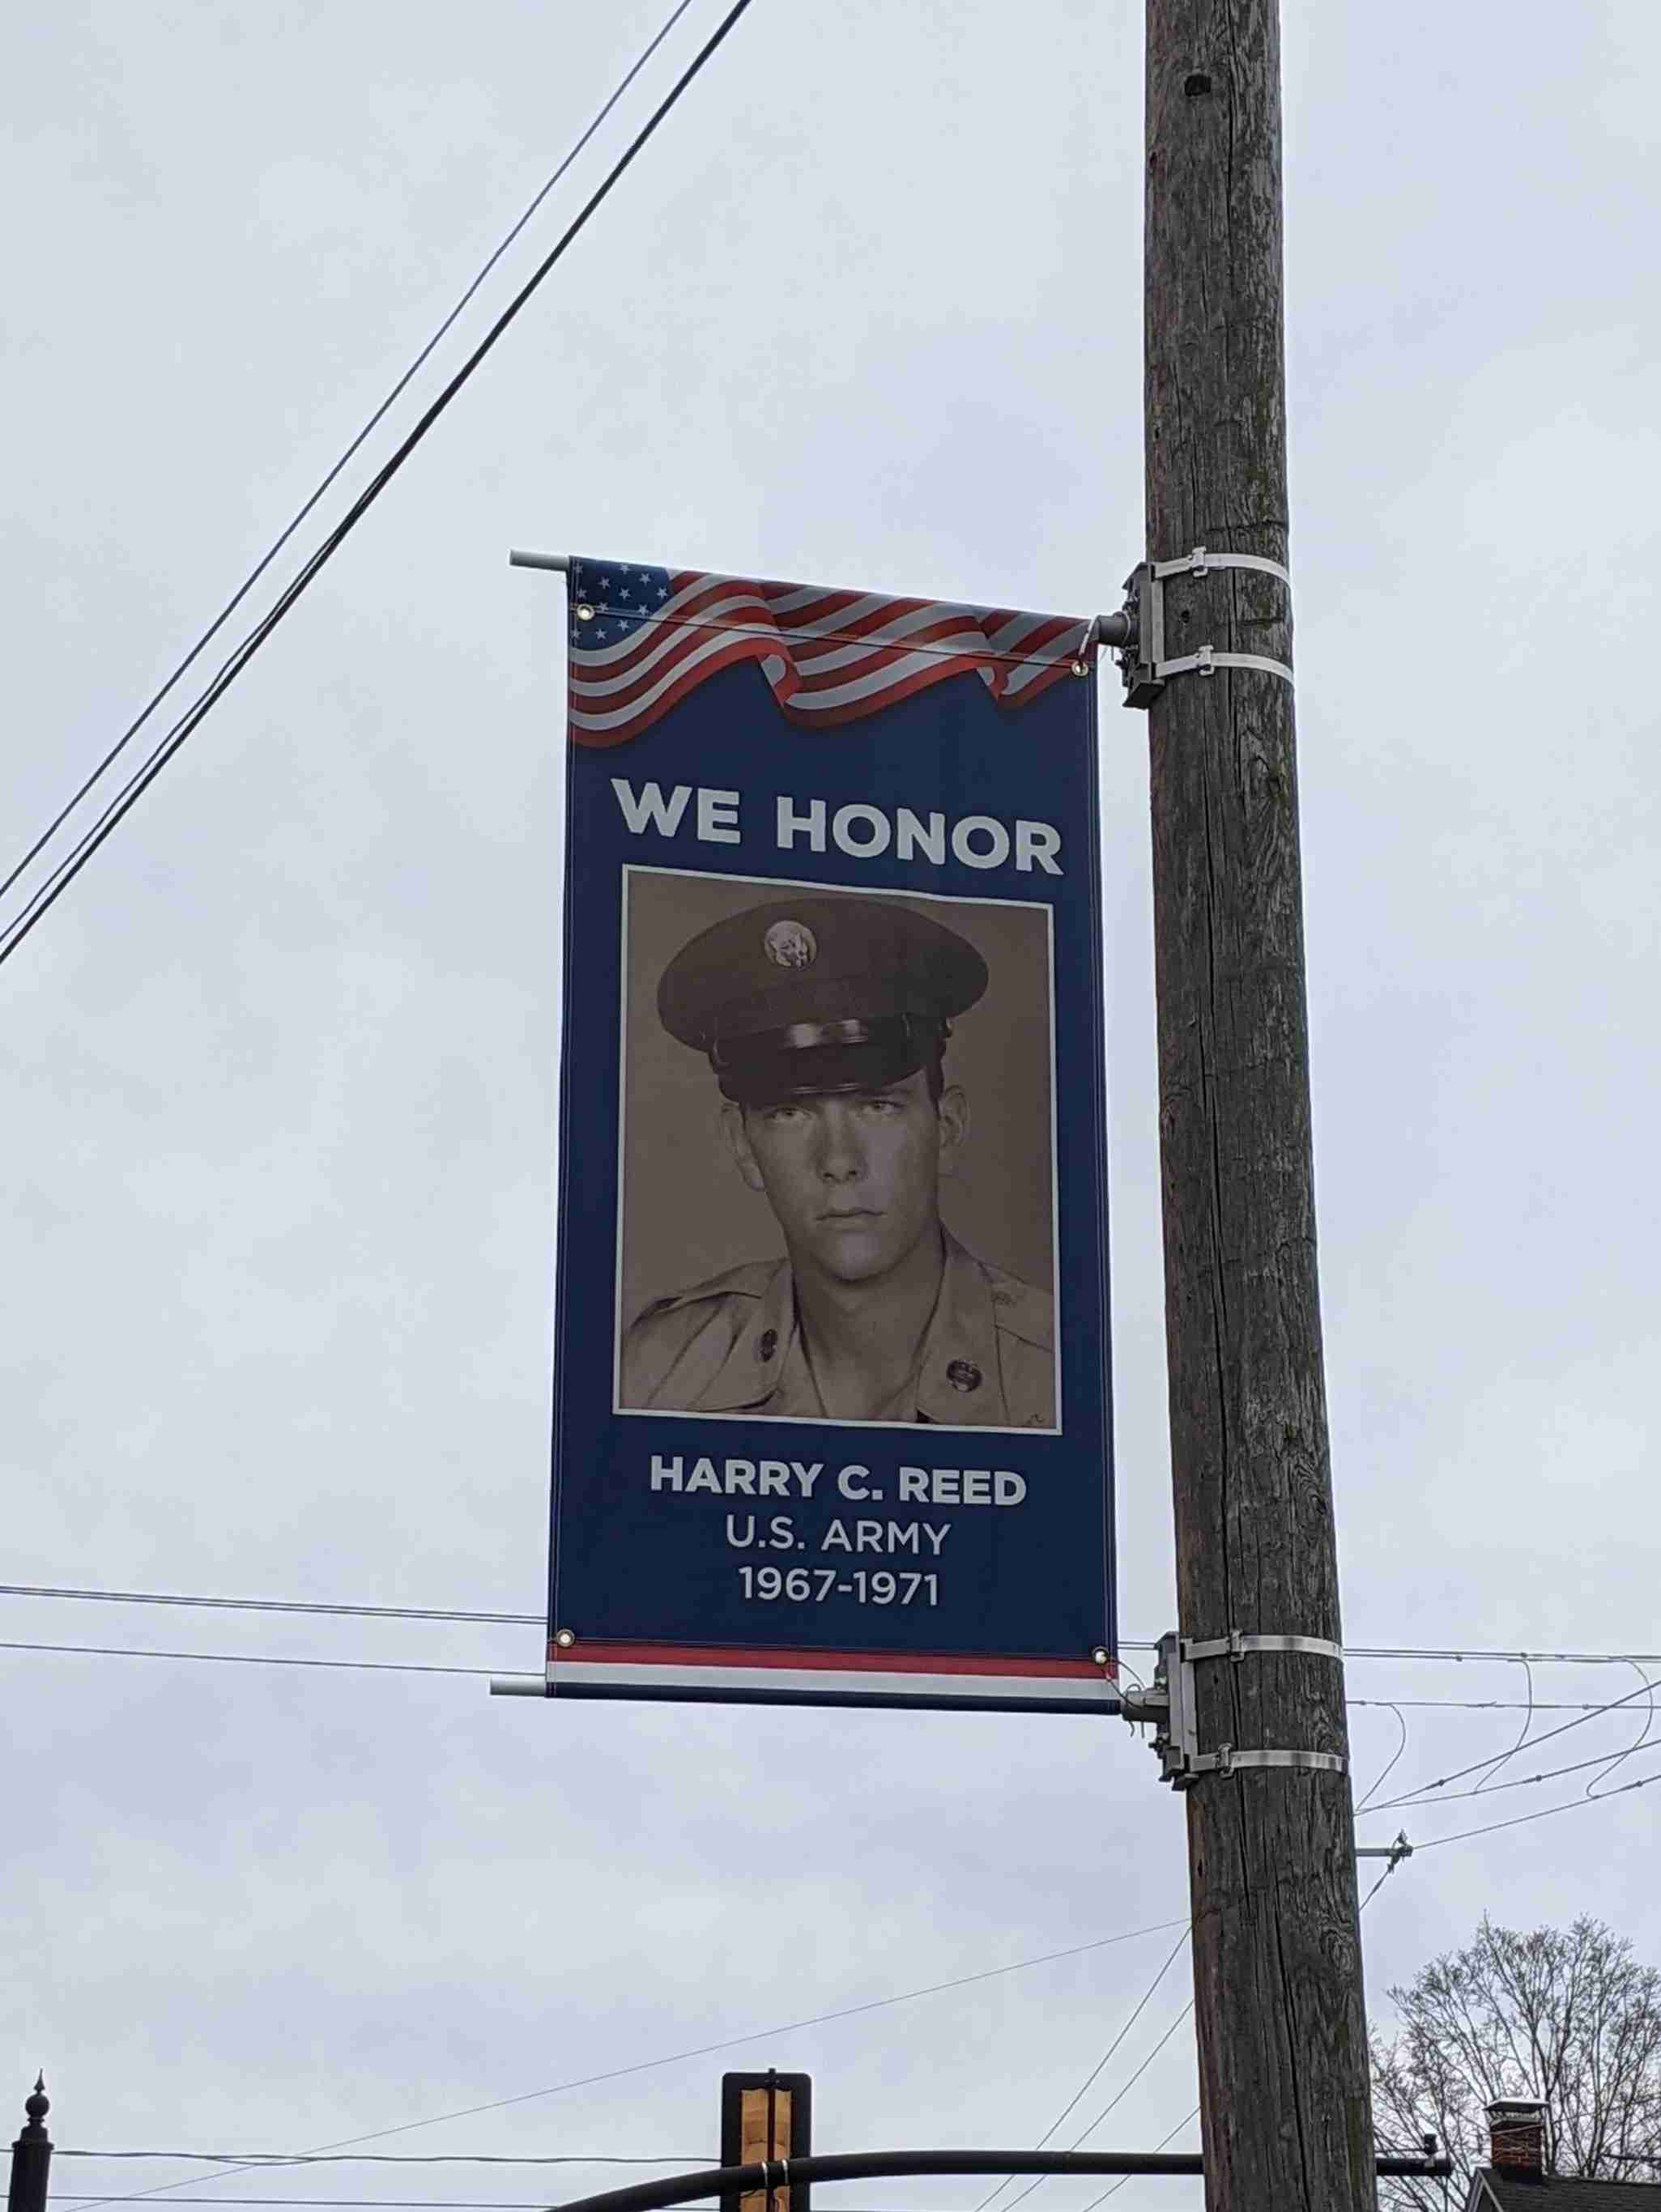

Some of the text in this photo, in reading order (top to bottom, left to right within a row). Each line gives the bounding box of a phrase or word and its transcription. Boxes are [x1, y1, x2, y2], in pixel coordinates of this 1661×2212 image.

[611, 778, 1064, 875] WE HONOR
[651, 1455, 1027, 1505] HARRY C. REED
[726, 1515, 951, 1555] U.S. ARMY
[739, 1567, 937, 1606] 1967-1971
